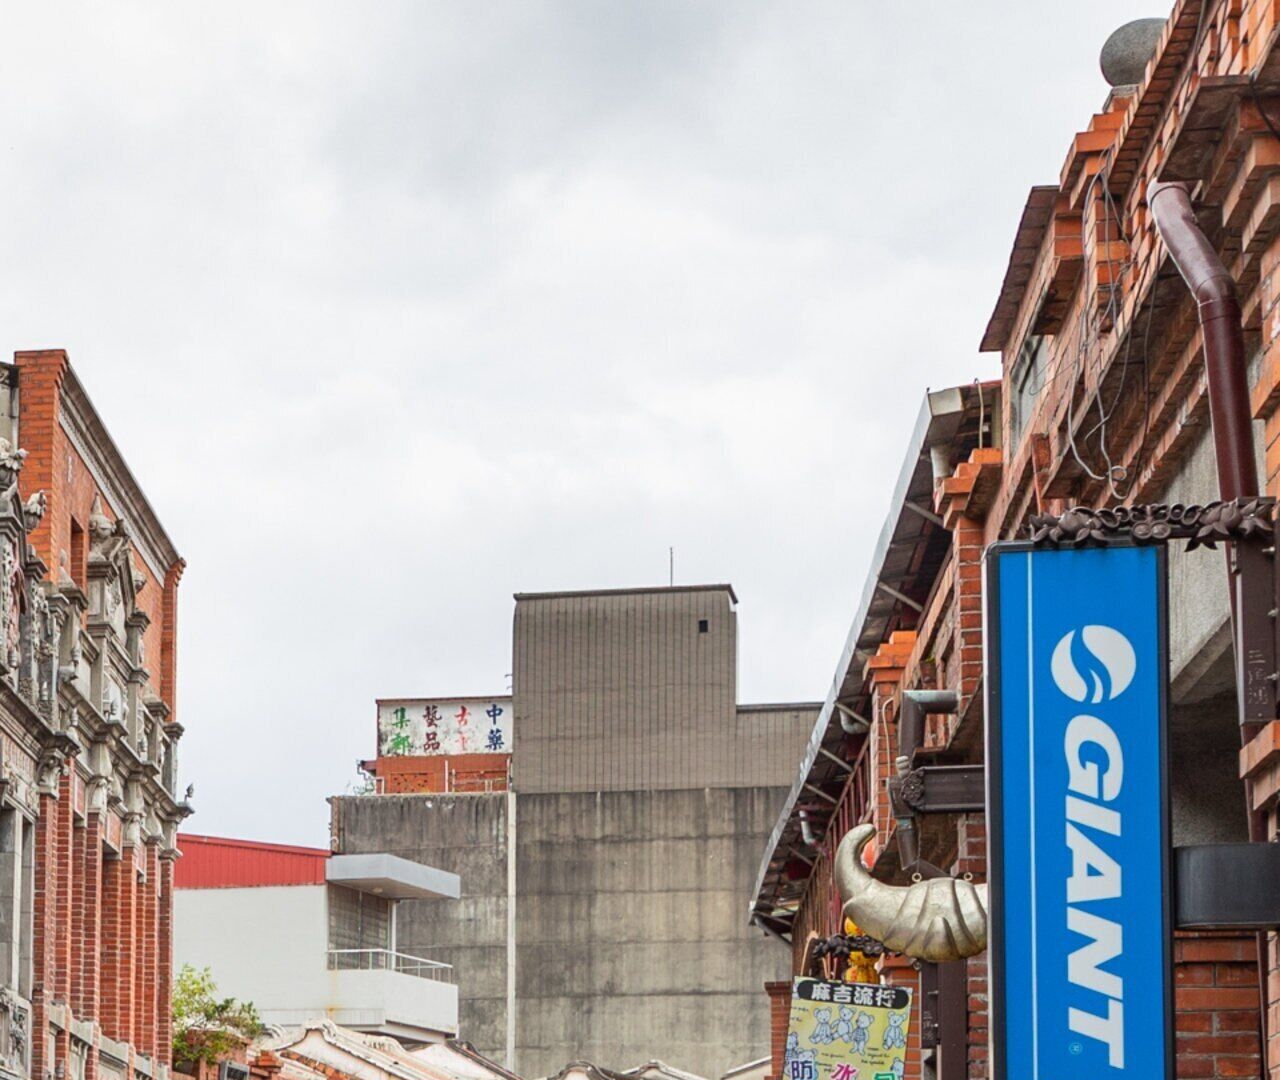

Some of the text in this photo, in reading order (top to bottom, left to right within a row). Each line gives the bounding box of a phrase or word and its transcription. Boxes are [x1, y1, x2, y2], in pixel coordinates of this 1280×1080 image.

[422, 705, 442, 751] 藝品
[485, 703, 505, 751] 中藥
[1063, 713, 1125, 1070] GIANT
[811, 982, 897, 1008] 麻吉流行
